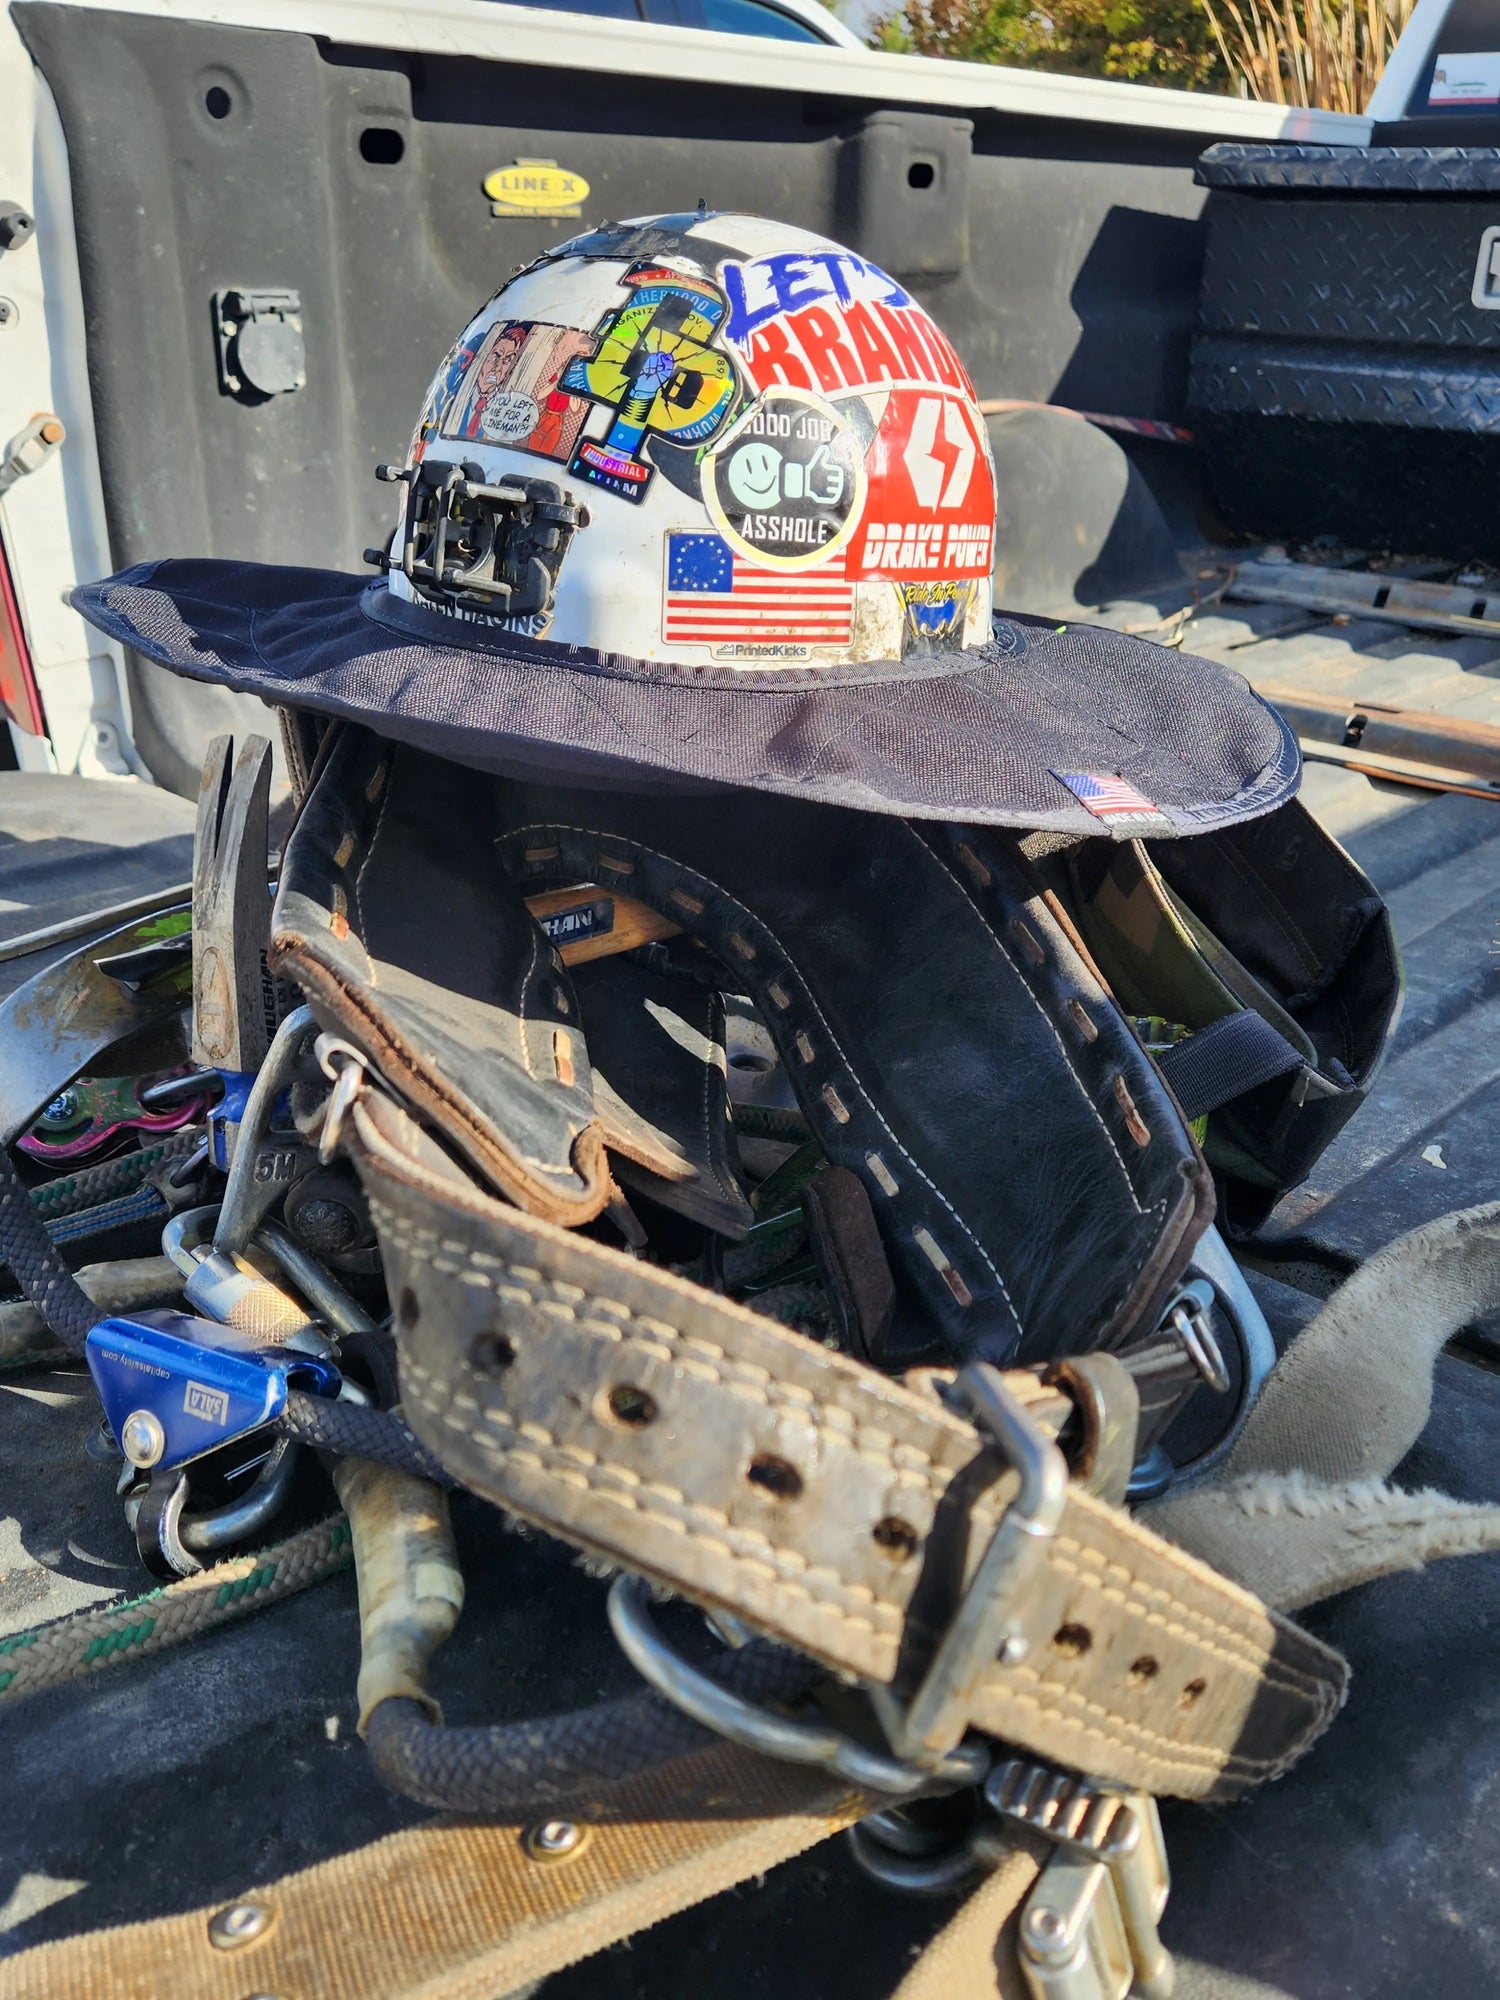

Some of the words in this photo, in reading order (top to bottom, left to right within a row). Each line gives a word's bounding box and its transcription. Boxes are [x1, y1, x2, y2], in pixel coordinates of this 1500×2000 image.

[500, 176, 551, 192] LINE
[723, 253, 911, 352] LET'S
[740, 300, 978, 405] BRAND
[488, 407, 503, 418] ME
[503, 408, 522, 421] FOR
[522, 413, 532, 424] A
[490, 397, 511, 407] YOU
[512, 399, 534, 412] LEFT
[796, 416, 834, 442] JOB
[585, 448, 641, 478] INDUSTRIAL
[740, 513, 829, 544] ASSHOLE
[861, 522, 944, 569] DRAKE
[943, 523, 991, 569] POWER
[735, 644, 807, 657] PrintedKicks
[101, 1349, 171, 1380] capitalsafety.com
[190, 1388, 224, 1416] SALA
